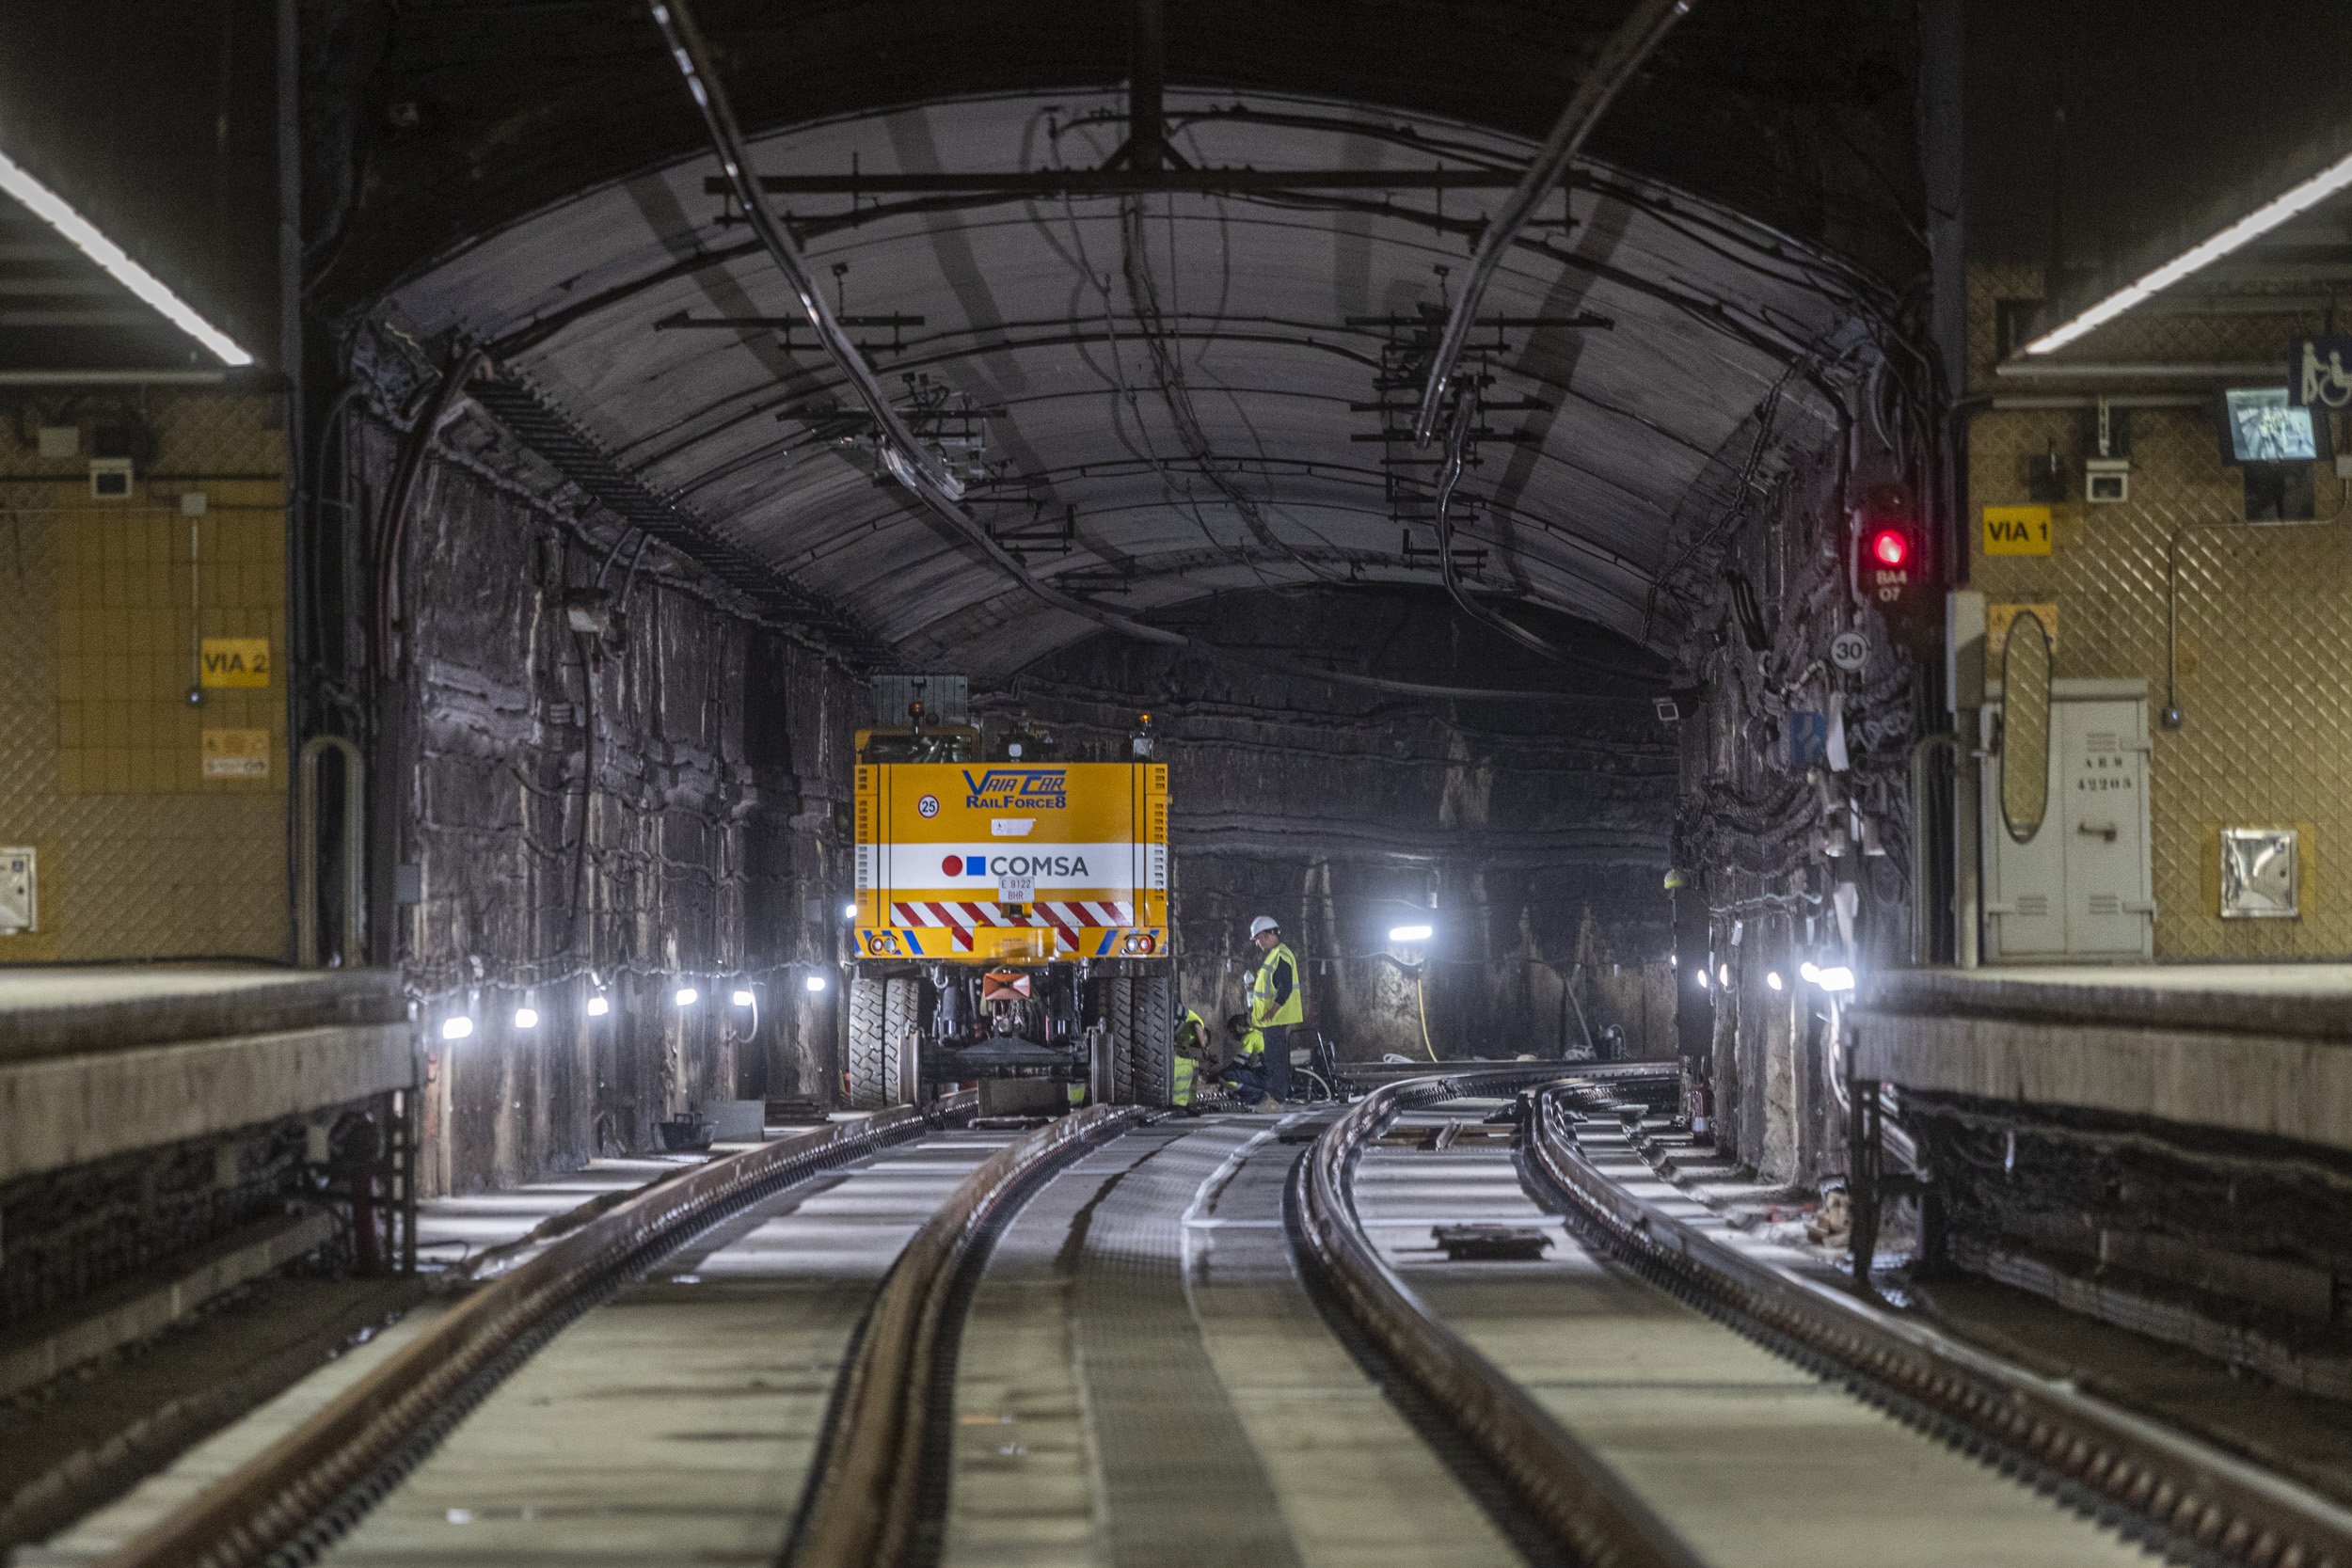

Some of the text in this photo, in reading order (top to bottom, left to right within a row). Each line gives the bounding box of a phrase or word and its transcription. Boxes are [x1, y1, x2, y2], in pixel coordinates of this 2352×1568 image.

[1988, 521, 2048, 542] VIA 1
[1836, 642, 1862, 660] 30
[204, 653, 266, 673] VIA 2
[961, 769, 1018, 796] VAIA
[922, 800, 936, 813] 25
[990, 856, 1089, 877] COMSA
